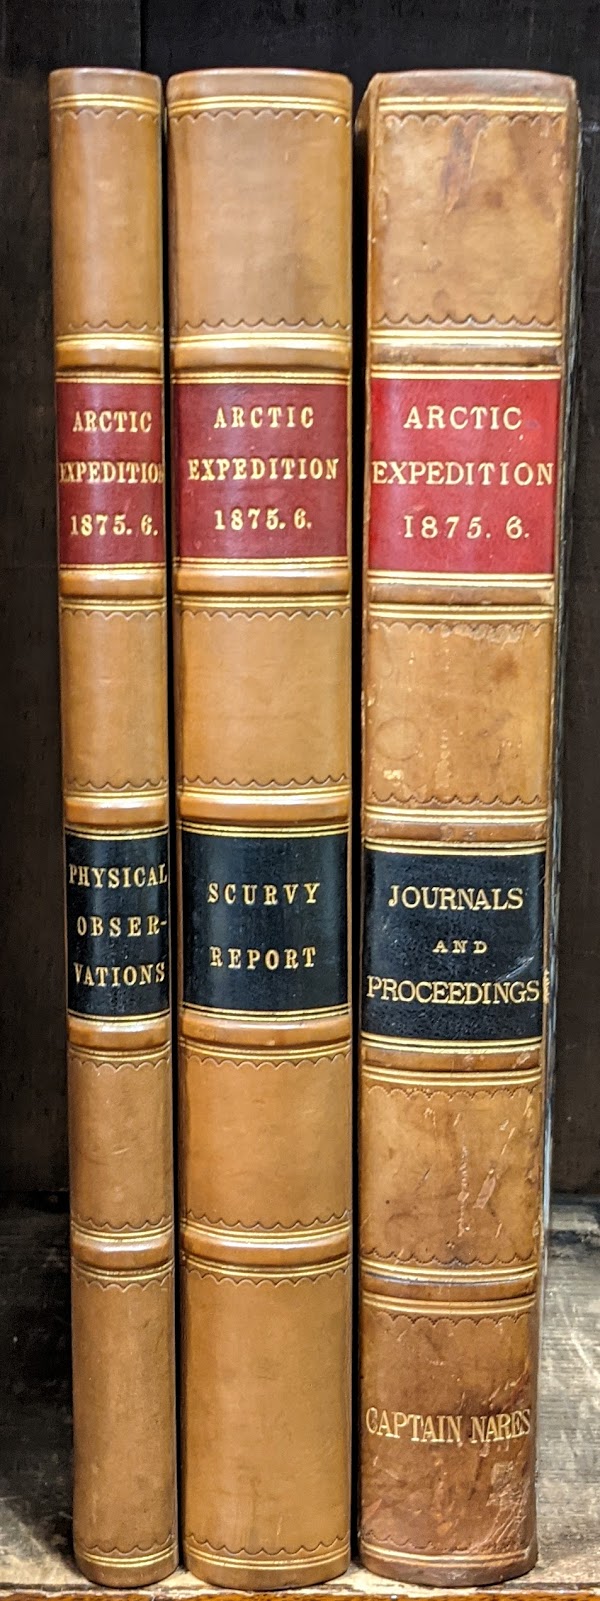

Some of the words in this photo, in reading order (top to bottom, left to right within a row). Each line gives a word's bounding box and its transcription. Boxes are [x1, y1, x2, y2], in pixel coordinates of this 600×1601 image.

[72, 410, 152, 432] ARCTIC
[213, 406, 314, 428] ARCTIC
[403, 405, 522, 430] ARCTIC
[187, 458, 339, 481] EXPEDITION
[372, 461, 554, 486] EXPEDITION
[68, 863, 168, 889] PHYSICAL
[207, 882, 320, 905] SCURVY
[388, 885, 524, 910] JOURNALS
[77, 915, 167, 937] OBSER-
[210, 946, 317, 970] REPORT
[432, 939, 488, 954] AND
[73, 961, 165, 987] VATIONS
[366, 975, 540, 1004] PROCEEDINGS
[365, 1407, 462, 1443] CAPTAIN
[470, 1408, 531, 1443] NARES
